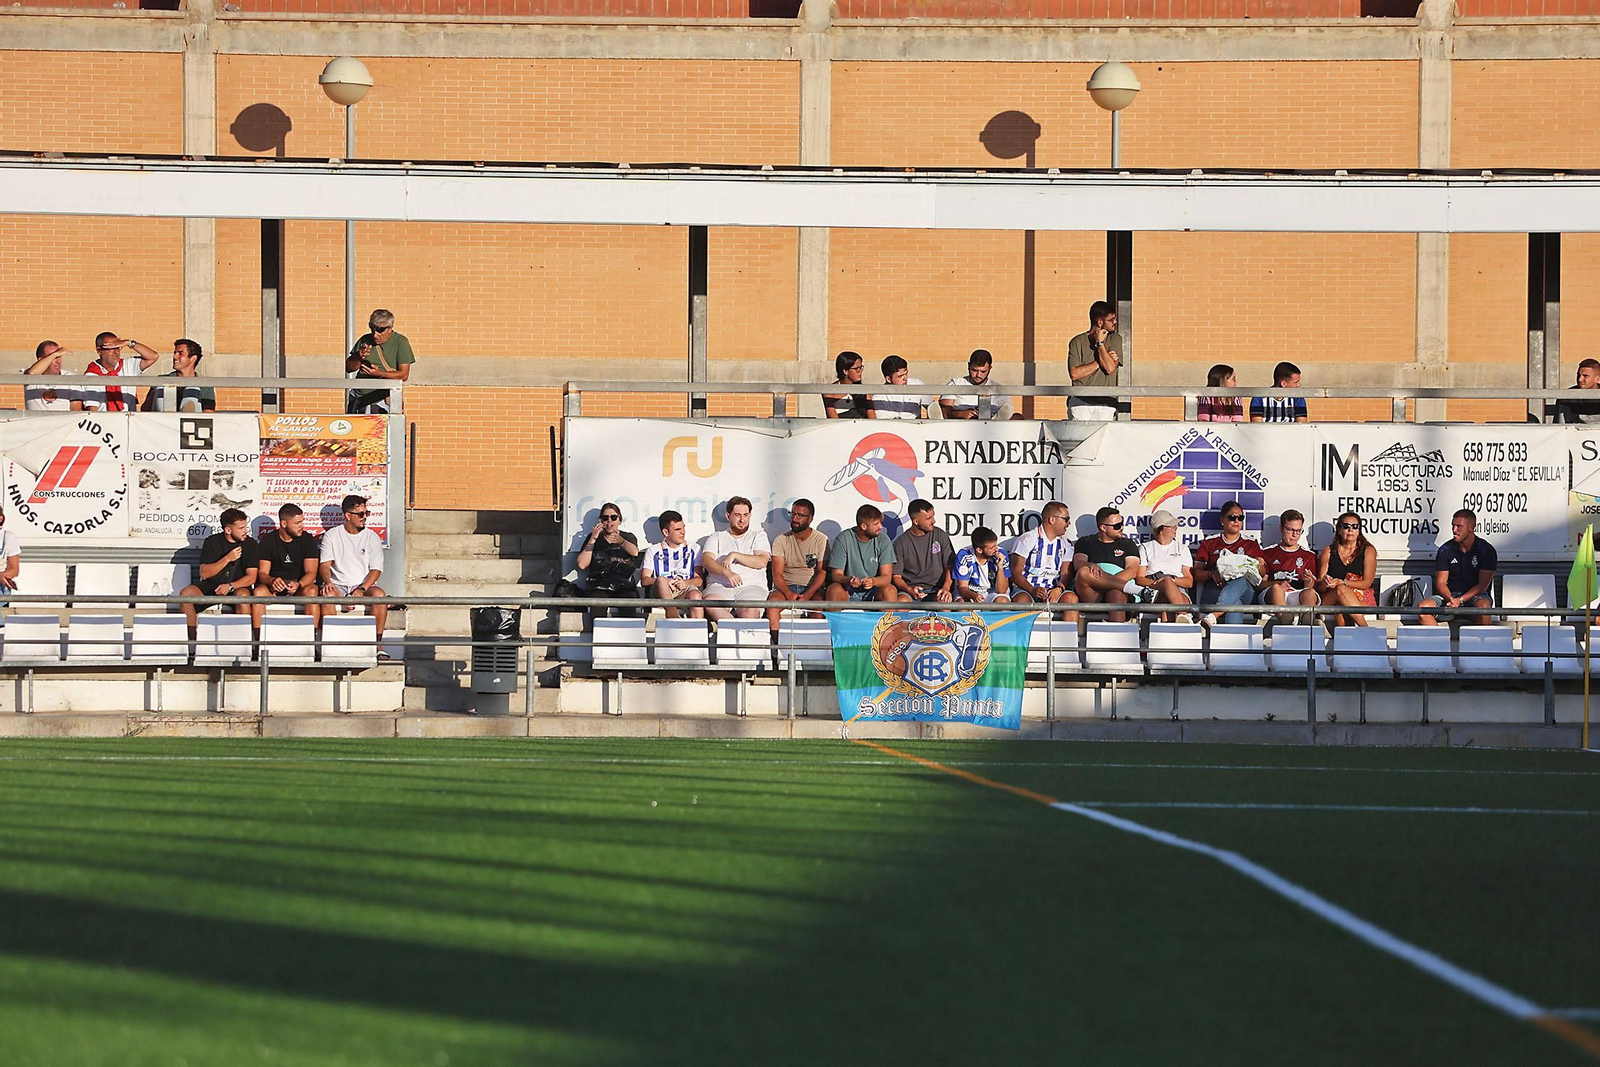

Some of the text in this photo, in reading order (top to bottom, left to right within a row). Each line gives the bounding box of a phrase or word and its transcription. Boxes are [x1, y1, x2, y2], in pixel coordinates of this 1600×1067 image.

[275, 416, 318, 426] POLLOS
[102, 433, 120, 459] S.L.
[924, 436, 1064, 464] PANADERÍA
[1463, 442, 1528, 462] 658 775 833
[133, 452, 260, 463] BOCATTA SHOP
[1108, 427, 1269, 509] CONSTRUCCIONES Y REFORMAS
[1361, 464, 1453, 477] ESTRUCTURAS
[1463, 466, 1492, 481] Manuel
[1493, 466, 1511, 481] Díaz
[33, 490, 106, 498] CONSTRUCCIONES
[932, 471, 1056, 500] EL DELFÍN
[1415, 480, 1436, 492] S.L.
[8, 483, 127, 535] HNOS. CAZORLA S.L.
[1338, 497, 1437, 514] FERRALLAS Y
[1463, 492, 1528, 512] 699 637 802
[139, 513, 185, 523] PEDIDOS
[188, 514, 195, 522] A
[1000, 509, 1043, 536] RÍO
[1484, 518, 1510, 536] Iglesias
[188, 525, 207, 536] 667
[886, 641, 907, 665] 1889
[857, 692, 1004, 719] Sección Punta
